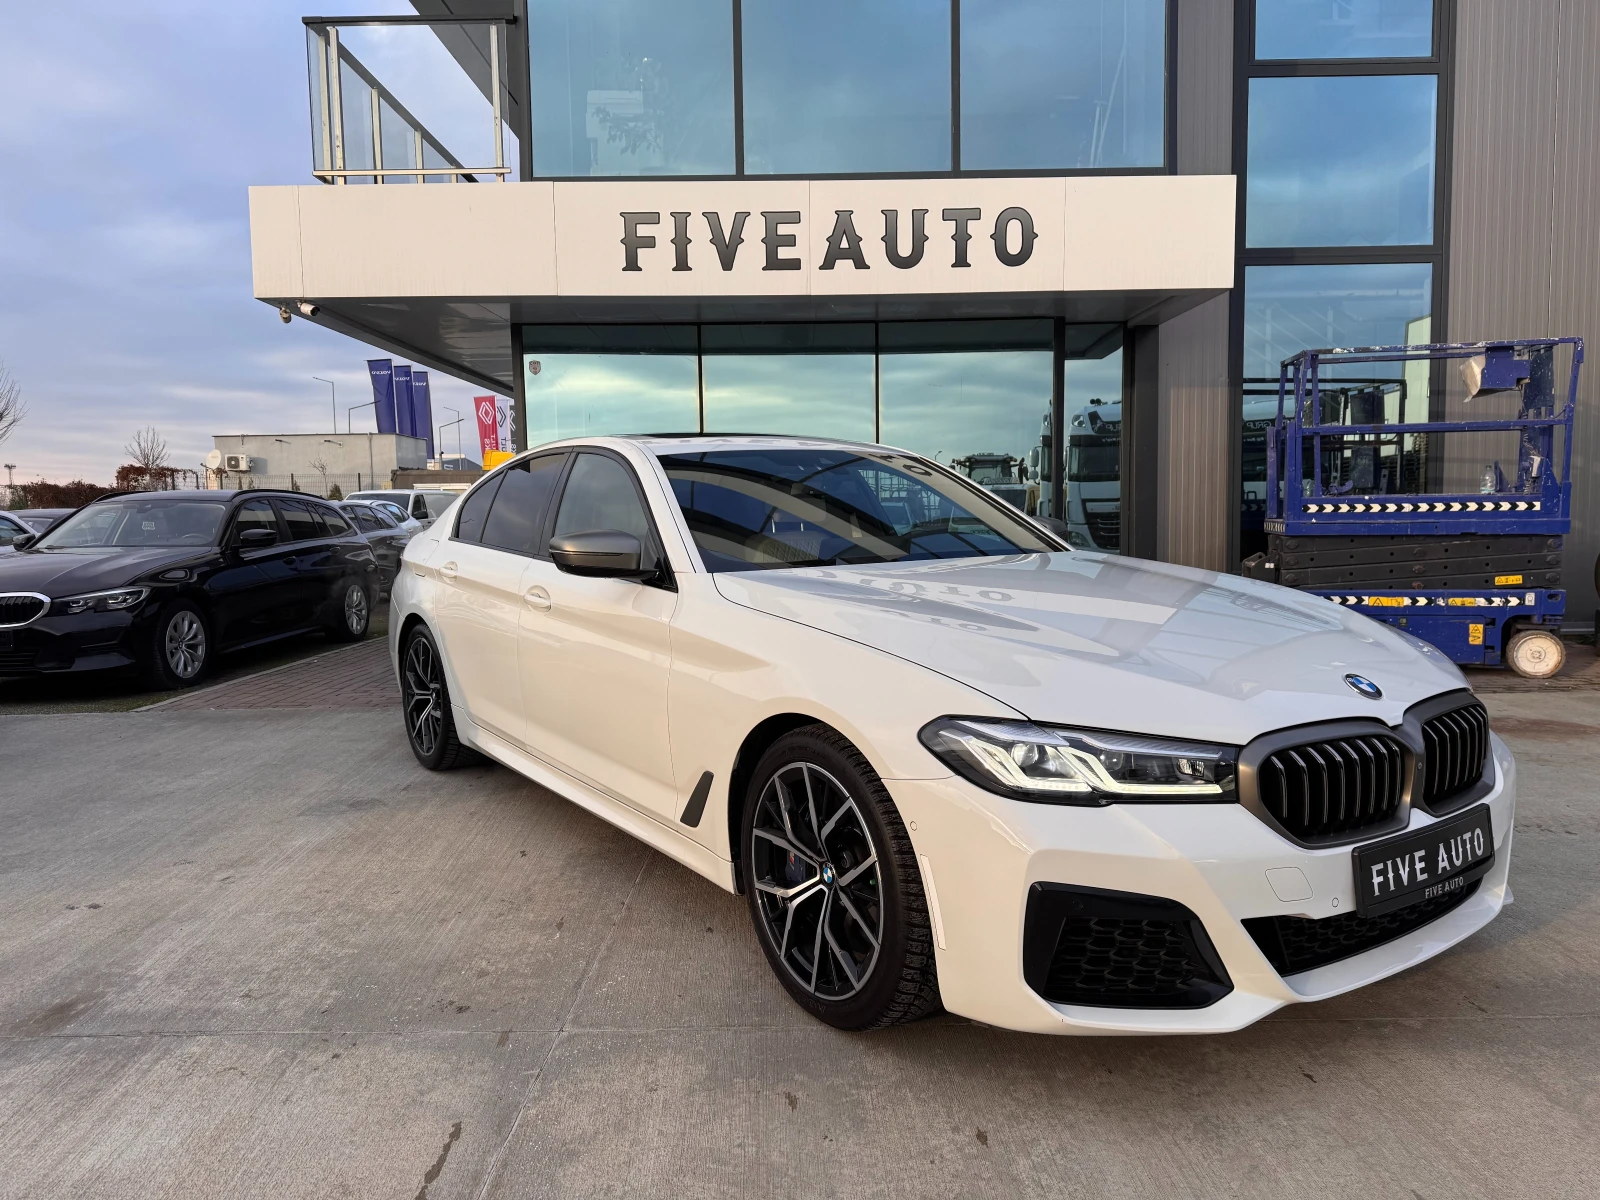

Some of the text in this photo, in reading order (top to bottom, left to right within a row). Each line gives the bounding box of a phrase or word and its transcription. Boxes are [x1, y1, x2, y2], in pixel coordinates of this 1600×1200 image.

[1370, 827, 1484, 897] FIVE AUTO
[1425, 876, 1464, 899] FIVE AUTO
